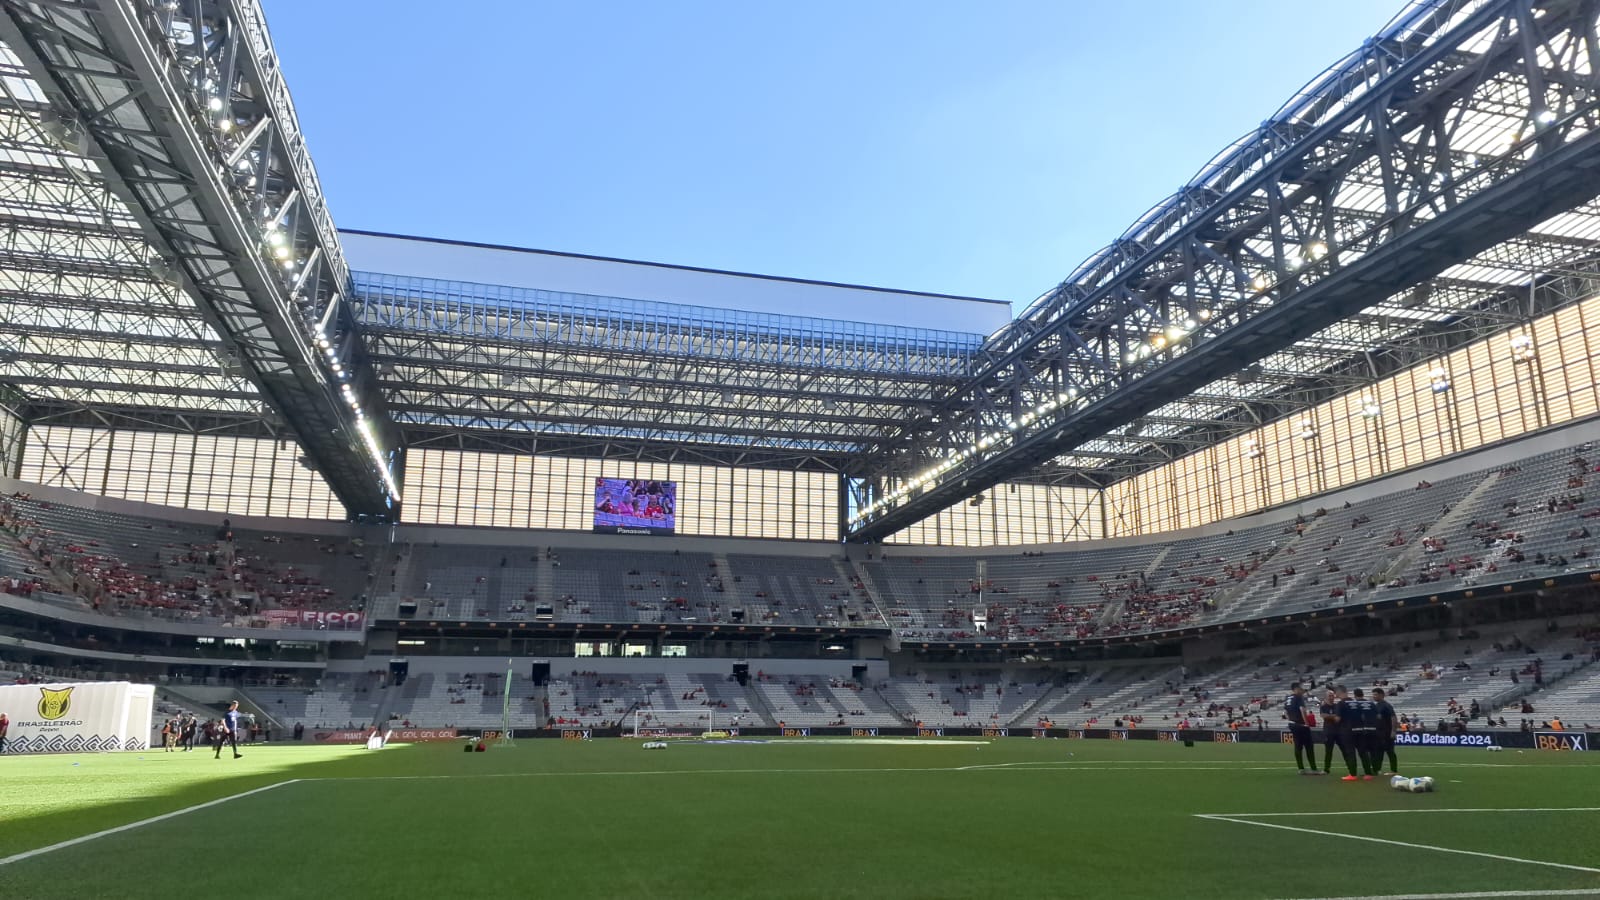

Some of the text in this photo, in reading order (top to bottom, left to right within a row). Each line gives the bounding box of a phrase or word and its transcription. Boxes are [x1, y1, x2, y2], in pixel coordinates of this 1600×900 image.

[303, 611, 360, 622] FICO
[564, 730, 589, 739] BRAX
[1160, 732, 1177, 741] BRAX
[1216, 732, 1237, 743] BRAX
[1422, 733, 1457, 744] Betano
[1460, 735, 1491, 745] 2024
[1539, 735, 1582, 751] BRAX
